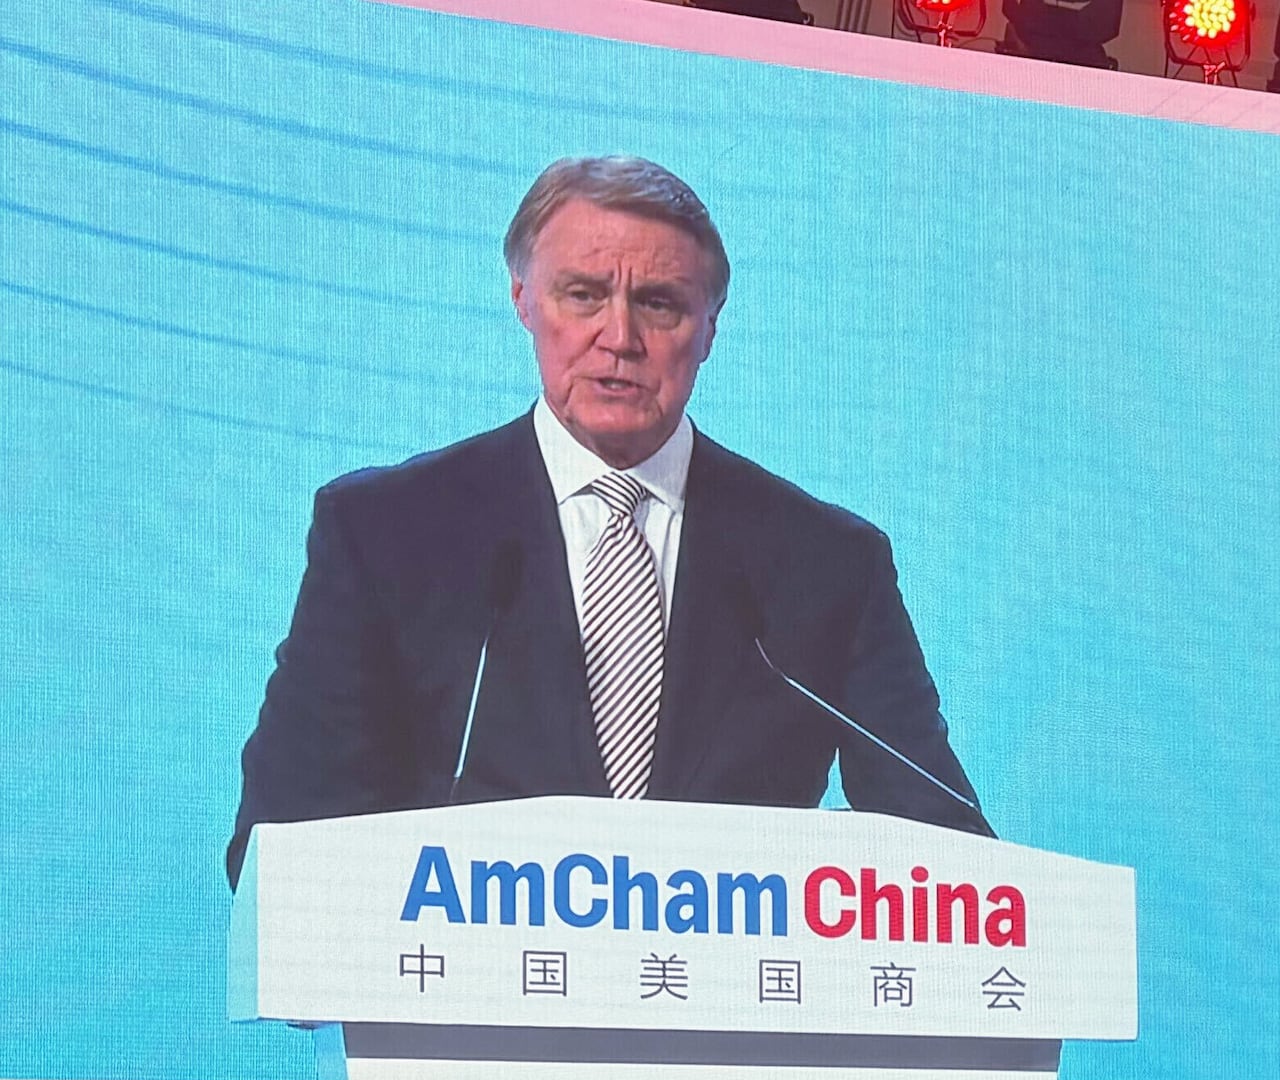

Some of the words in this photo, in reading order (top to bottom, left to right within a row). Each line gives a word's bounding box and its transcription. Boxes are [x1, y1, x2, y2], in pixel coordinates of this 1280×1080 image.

[399, 845, 788, 937] AmCham
[803, 865, 1027, 948] China
[398, 943, 1027, 1012] 中国美国商会
